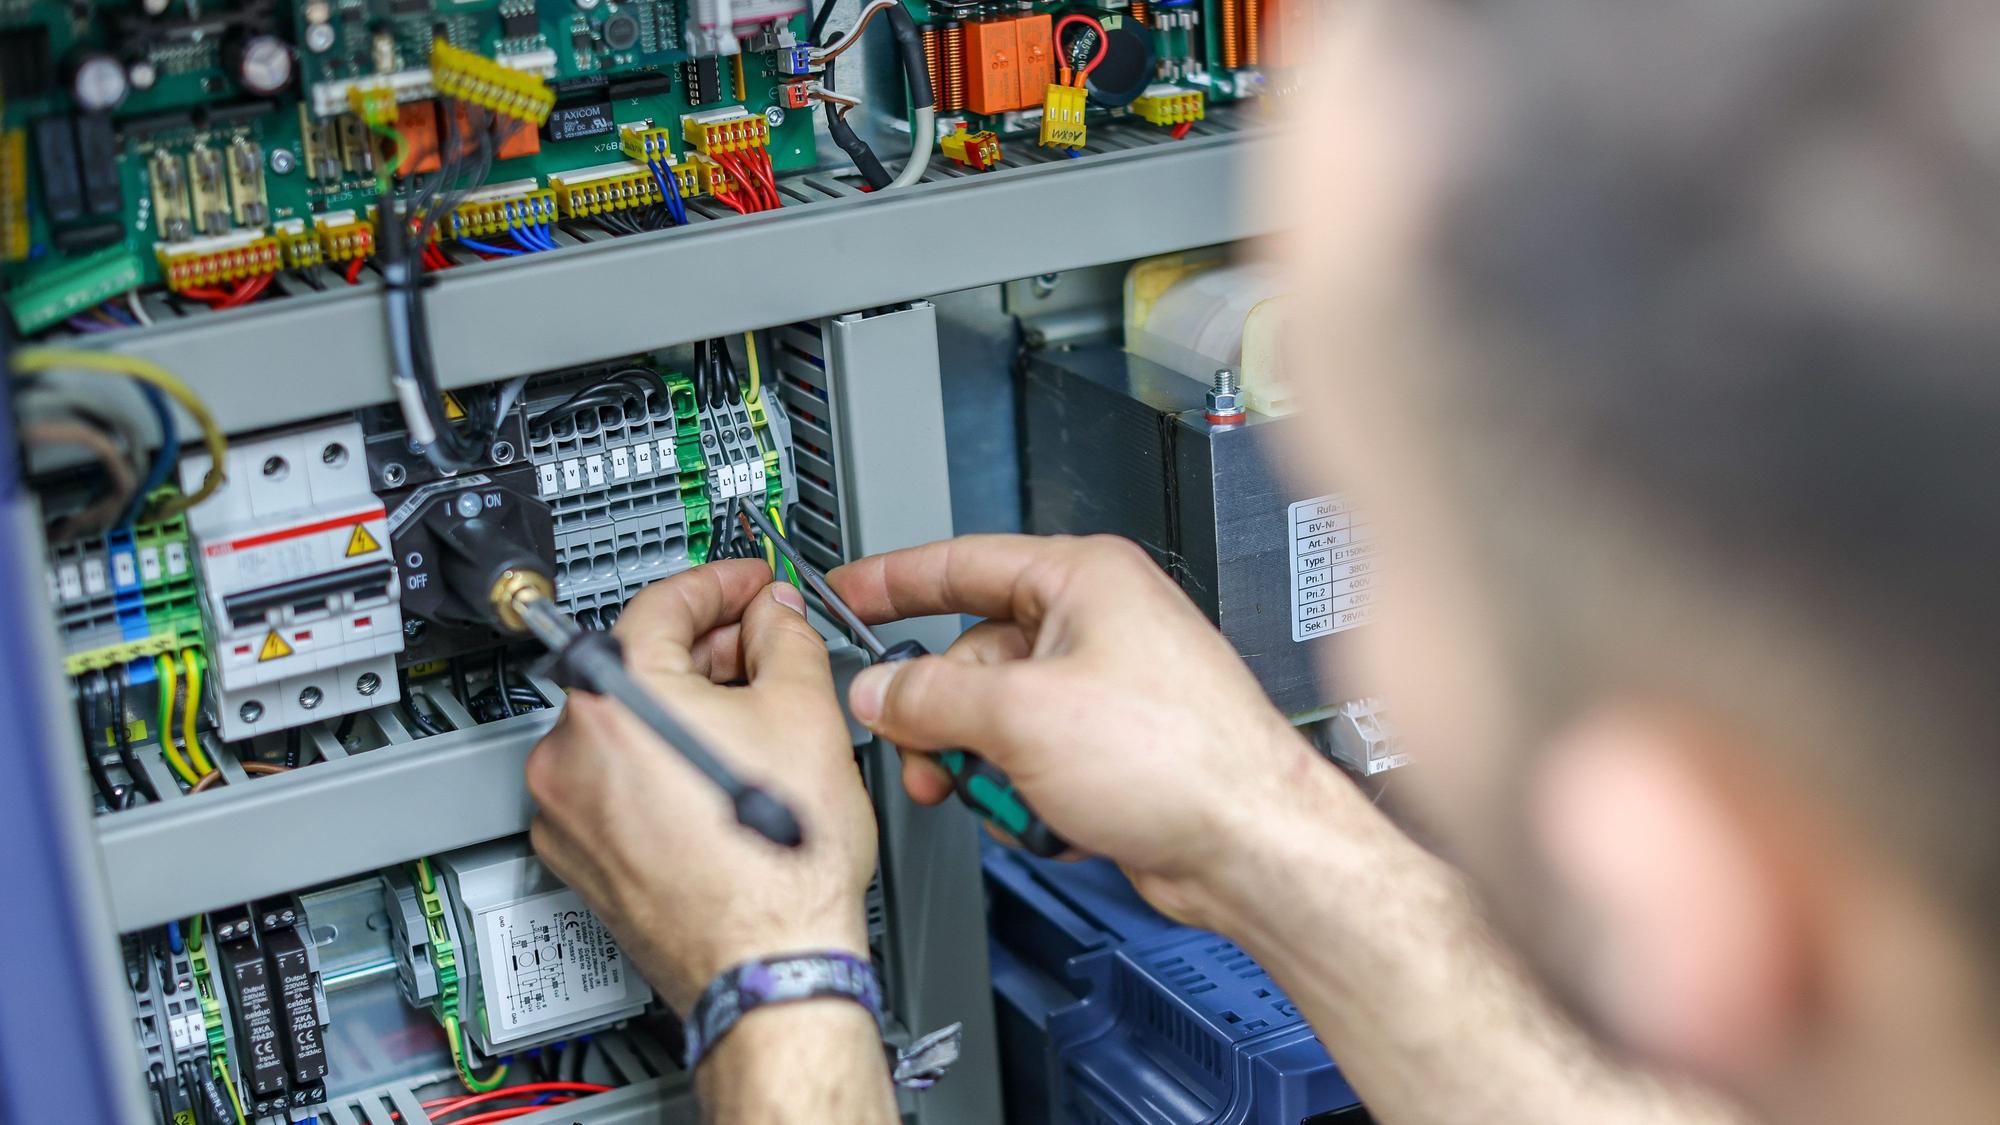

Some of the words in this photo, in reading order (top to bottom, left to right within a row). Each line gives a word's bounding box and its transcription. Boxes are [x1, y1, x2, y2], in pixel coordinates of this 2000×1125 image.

[564, 107, 601, 120] AXICOM
[640, 453, 649, 461] L2
[663, 448, 672, 457] L3
[617, 458, 625, 466] L1
[547, 474, 552, 482] U
[739, 474, 748, 482] L2
[755, 471, 763, 479] L3
[723, 478, 731, 486] L1
[485, 494, 502, 508] ON
[1304, 556, 1325, 568] Type
[407, 573, 428, 590] OFF
[1305, 573, 1324, 585] Pri.1
[1306, 588, 1326, 600] Pri.2
[1306, 604, 1326, 616] Pri.3
[1305, 619, 1328, 632] Sek.1
[285, 973, 307, 983] Output
[285, 980, 309, 990] 230VAC
[287, 998, 313, 1009] celduc
[294, 1014, 313, 1024] XKA
[293, 1020, 316, 1032] 70420
[300, 1043, 317, 1052] Input
